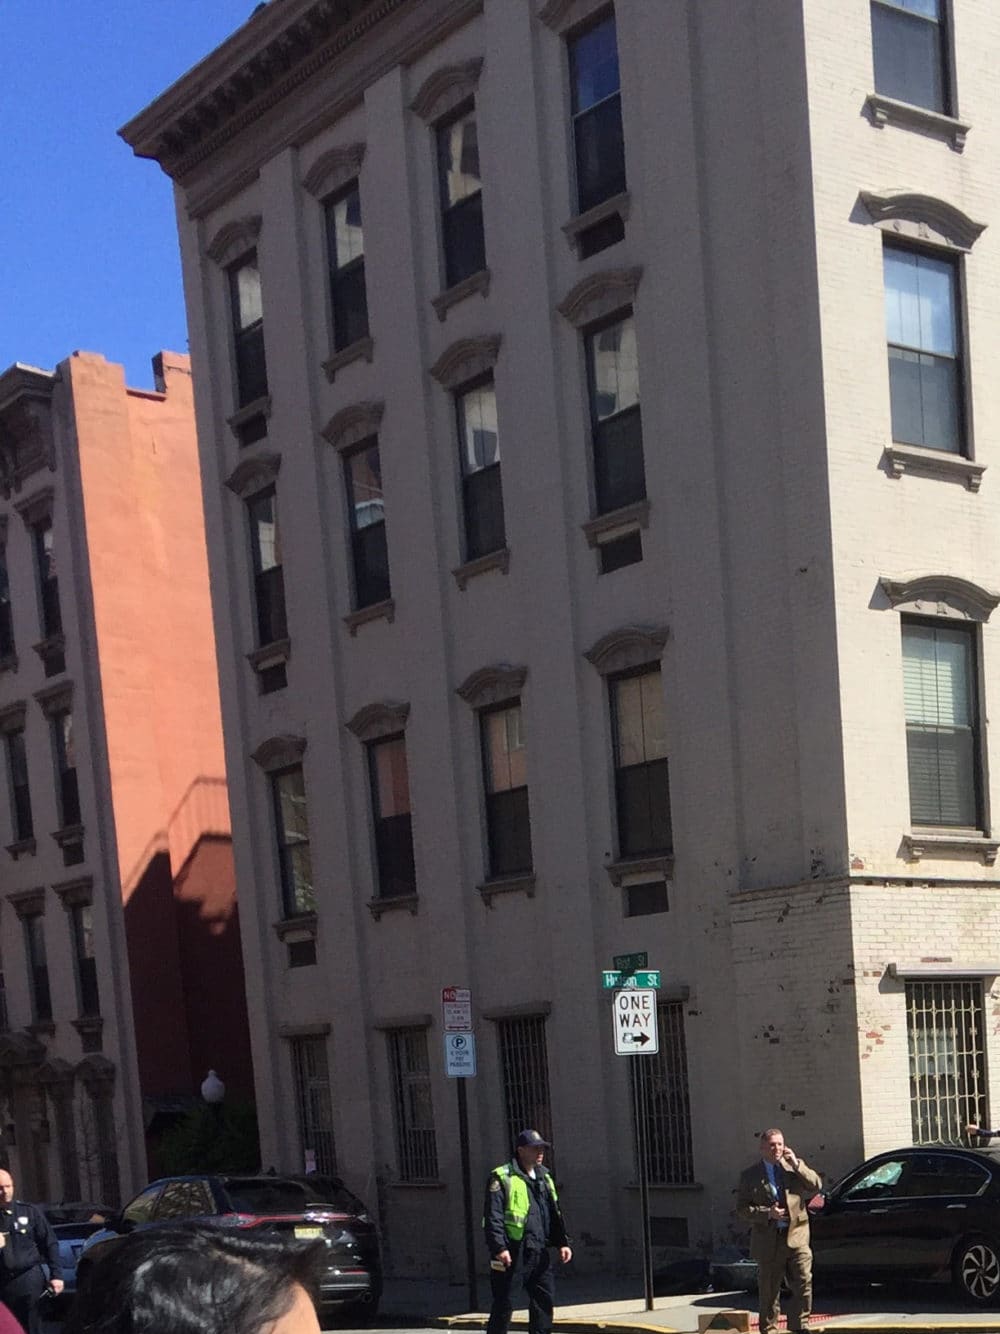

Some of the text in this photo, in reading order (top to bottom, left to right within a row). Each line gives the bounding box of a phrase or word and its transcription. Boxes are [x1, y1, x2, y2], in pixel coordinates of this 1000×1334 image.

[647, 974, 658, 986] St
[443, 990, 456, 1000] NO
[619, 995, 650, 1010] ONE
[619, 1013, 651, 1028] WAY
[455, 1038, 463, 1048] P
